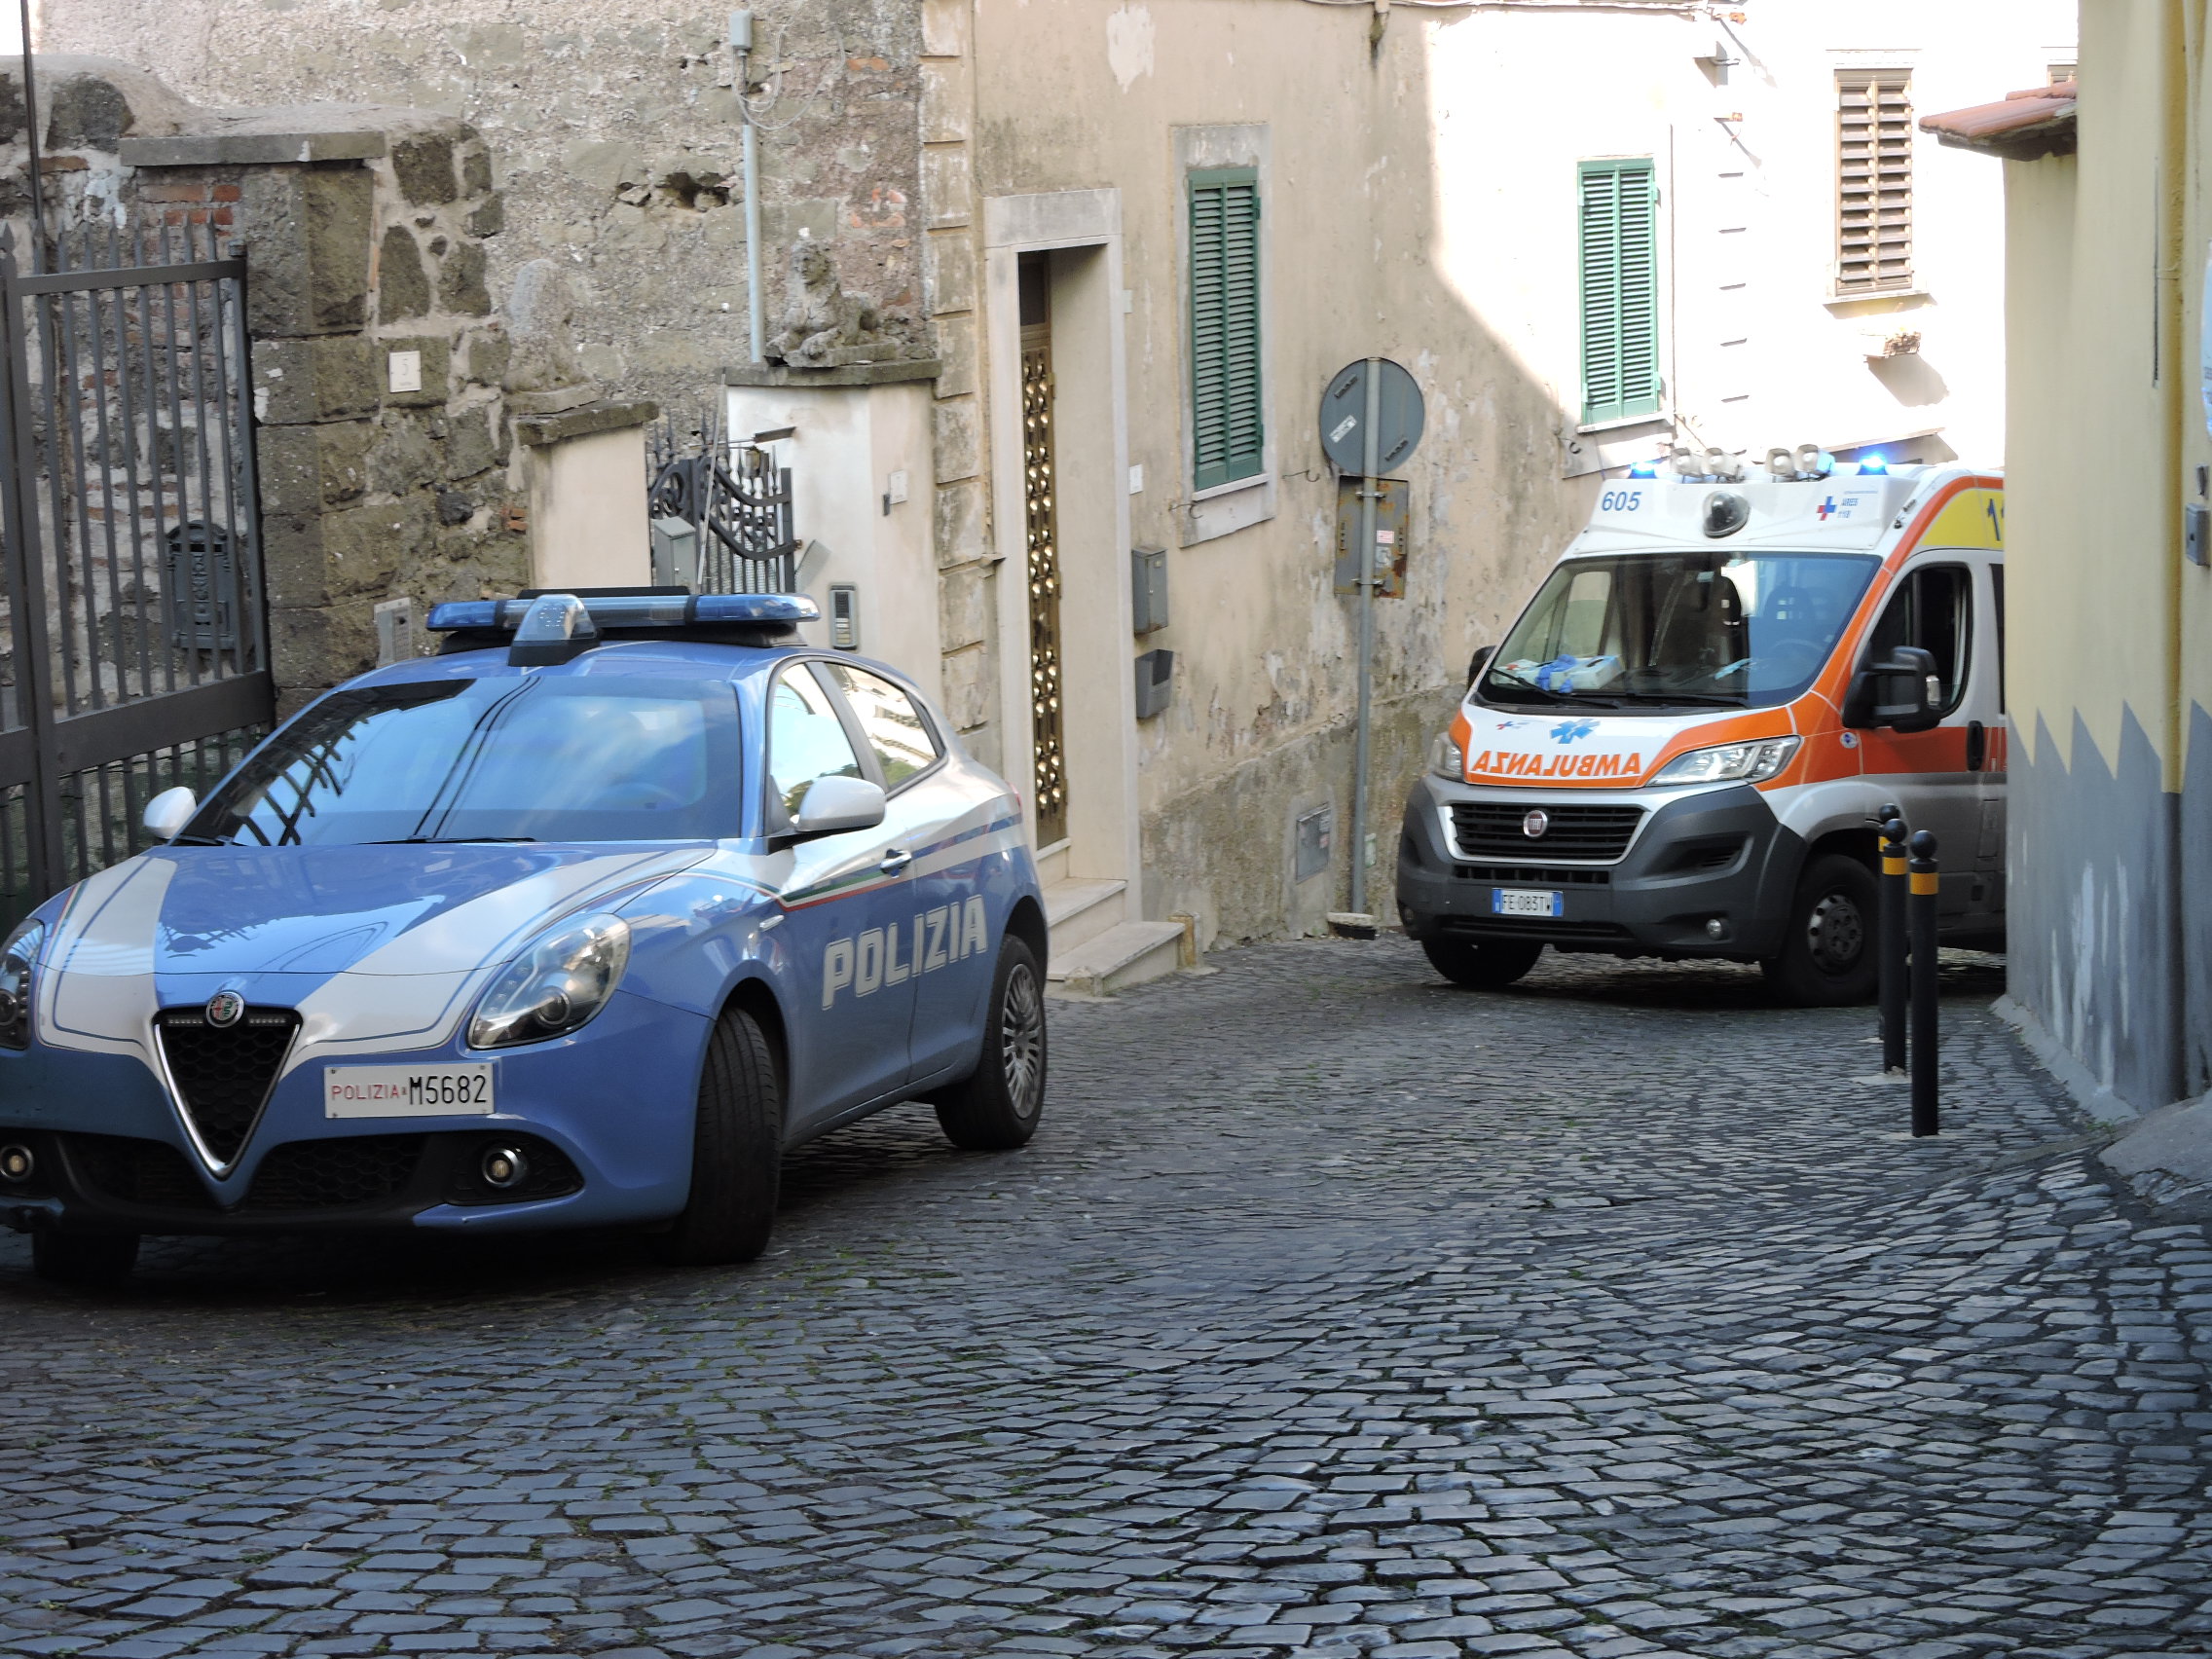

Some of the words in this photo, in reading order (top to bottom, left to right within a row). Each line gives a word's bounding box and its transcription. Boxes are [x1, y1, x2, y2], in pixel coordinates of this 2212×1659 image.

[1602, 491, 1642, 512] 605
[821, 894, 988, 1012] POLIZIA
[331, 1084, 400, 1100] POLIZIA
[409, 1074, 487, 1106] M5682
